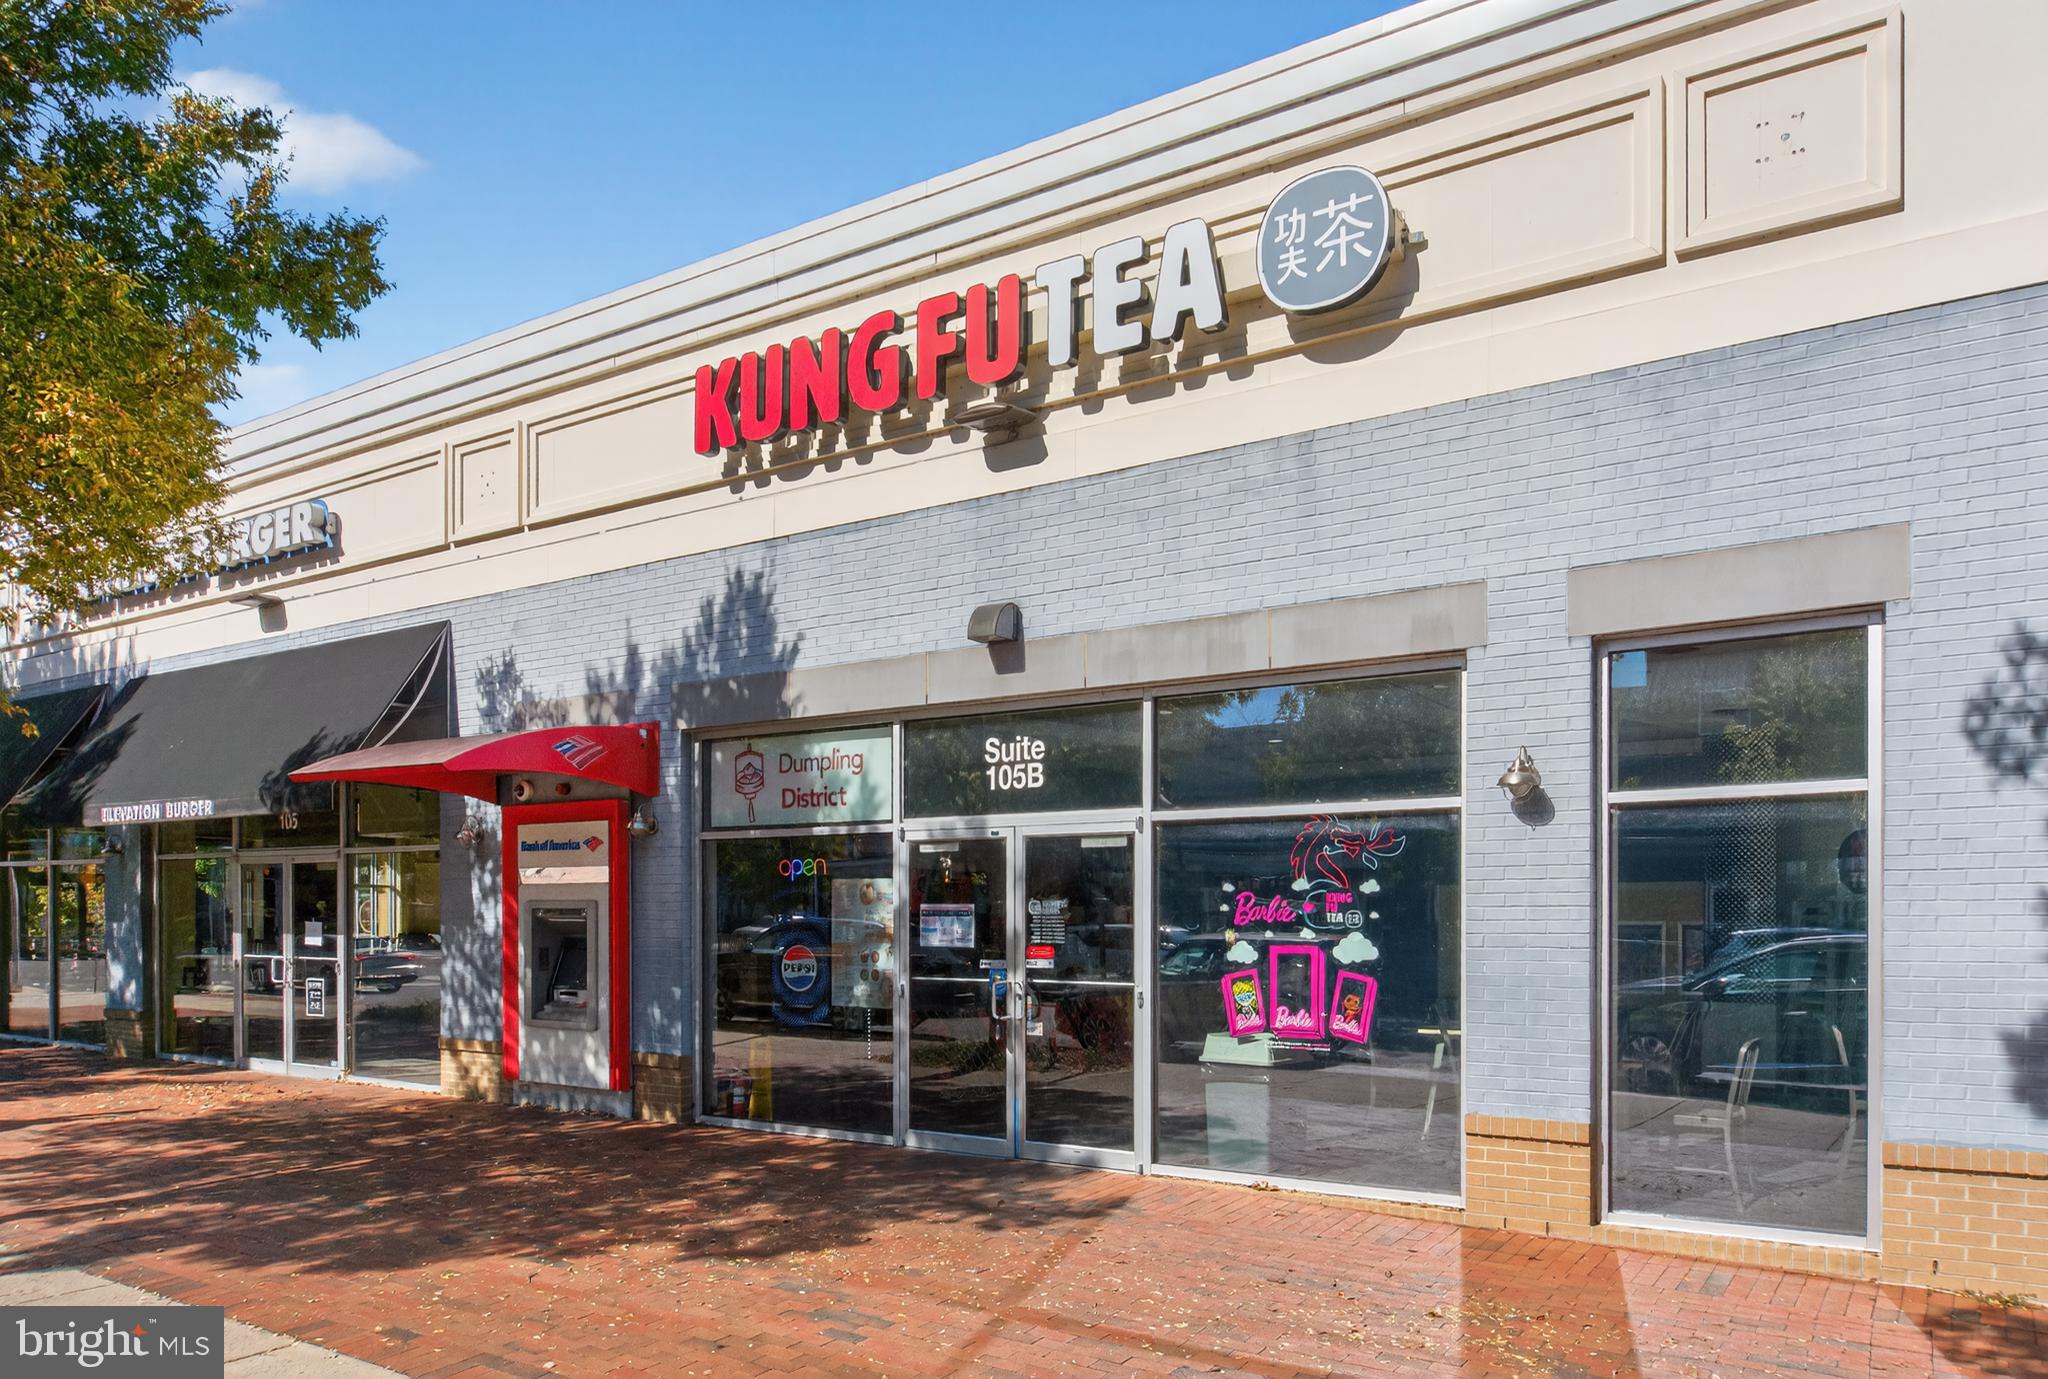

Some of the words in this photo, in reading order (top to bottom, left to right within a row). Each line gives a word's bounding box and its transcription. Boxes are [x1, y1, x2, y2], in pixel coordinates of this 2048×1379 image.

[694, 310, 910, 456] KUNG
[916, 273, 1028, 400] FU
[1035, 217, 1229, 370] TEA
[779, 747, 864, 779] Dumpling
[984, 735, 1046, 764] Suite
[986, 762, 1044, 791] 105B
[165, 799, 214, 818] BURGER
[782, 785, 848, 809] District
[778, 857, 828, 882] open
[1233, 890, 1297, 926] Barbie
[1276, 1005, 1314, 1028] Barbie
